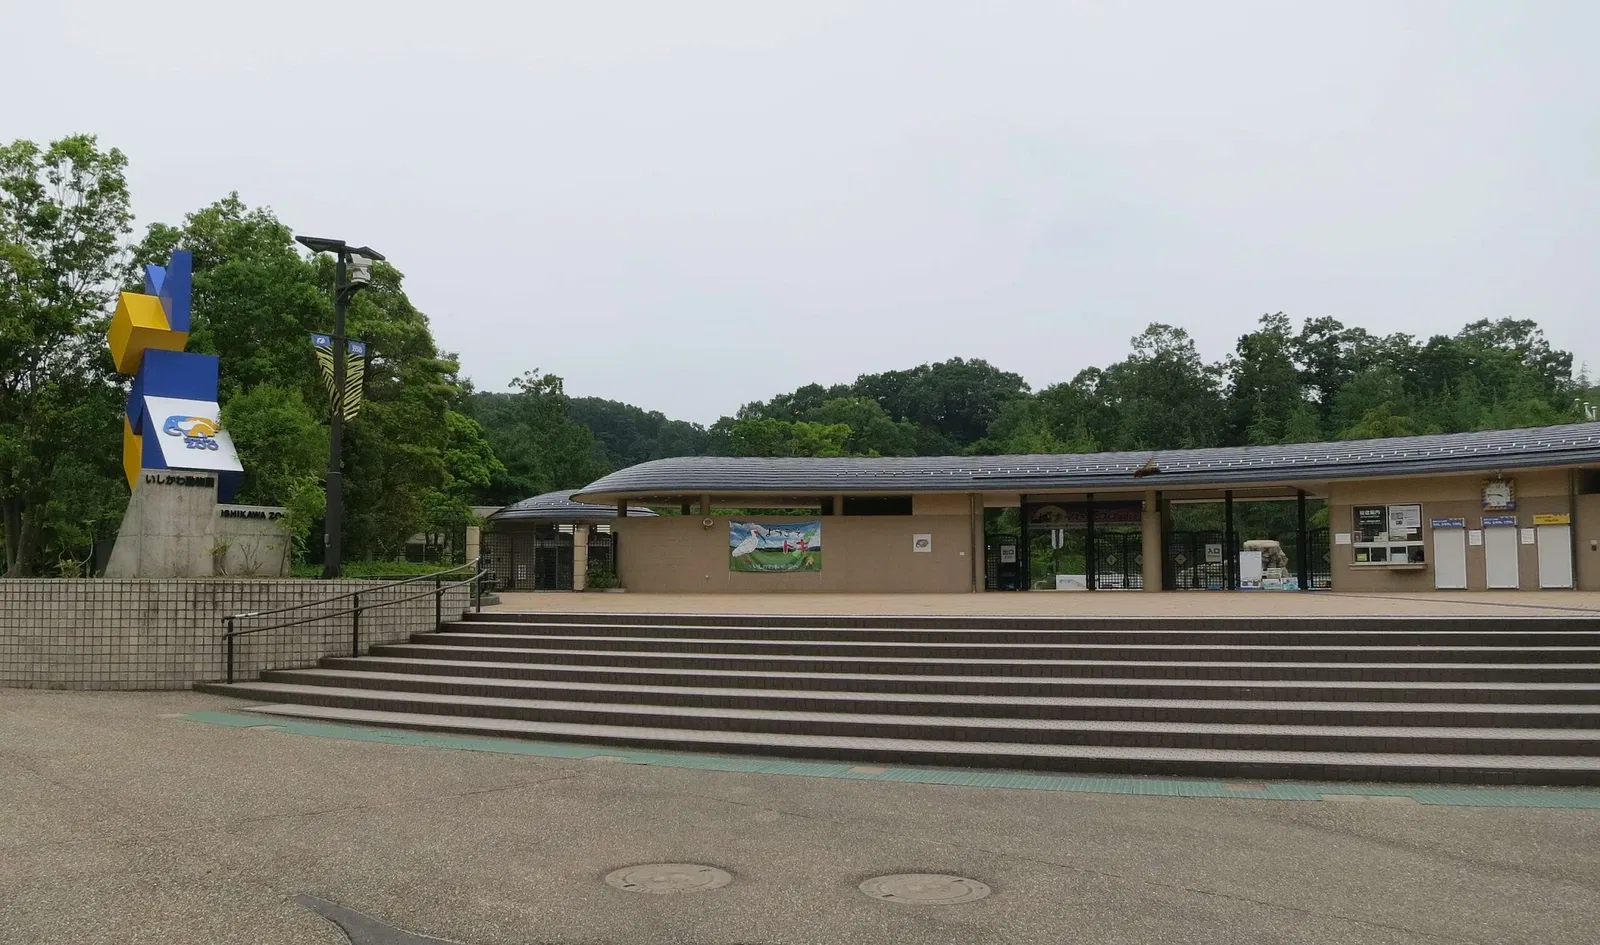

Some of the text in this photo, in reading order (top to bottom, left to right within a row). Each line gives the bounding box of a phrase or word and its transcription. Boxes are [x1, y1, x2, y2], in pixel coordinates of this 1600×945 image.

[220, 509, 266, 520] ISHIKAWA
[766, 527, 801, 537] ようこそ
[783, 539, 809, 554] トキ
